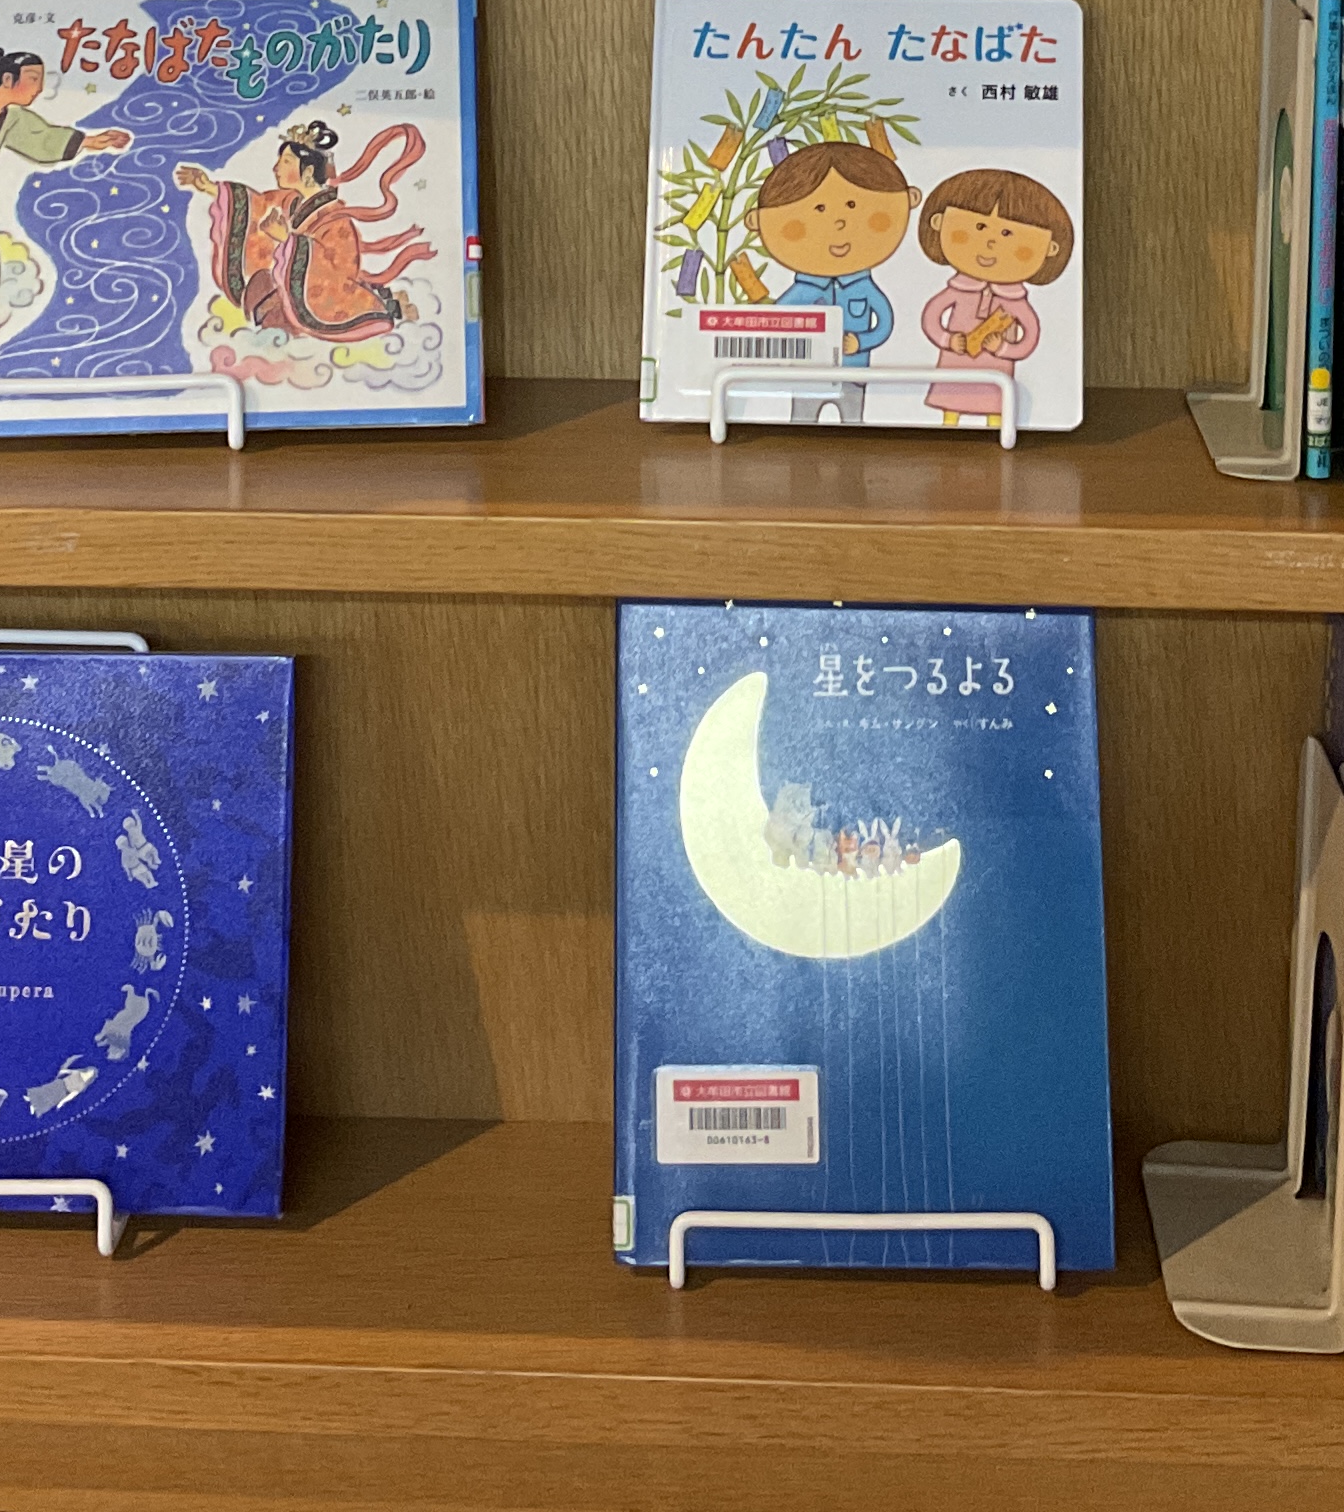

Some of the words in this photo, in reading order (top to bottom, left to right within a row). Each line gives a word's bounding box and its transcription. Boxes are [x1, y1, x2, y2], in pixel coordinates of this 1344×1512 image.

[58, 17, 432, 99] たなばたものがたり
[693, 21, 863, 60] たんたん
[887, 22, 1058, 65] たなばた
[948, 86, 969, 97] さく
[981, 85, 1016, 101] 西村
[1023, 84, 1060, 101] 敏雄
[721, 316, 819, 330] 大牟田市立図書館
[812, 653, 1015, 697] 星をつるよる
